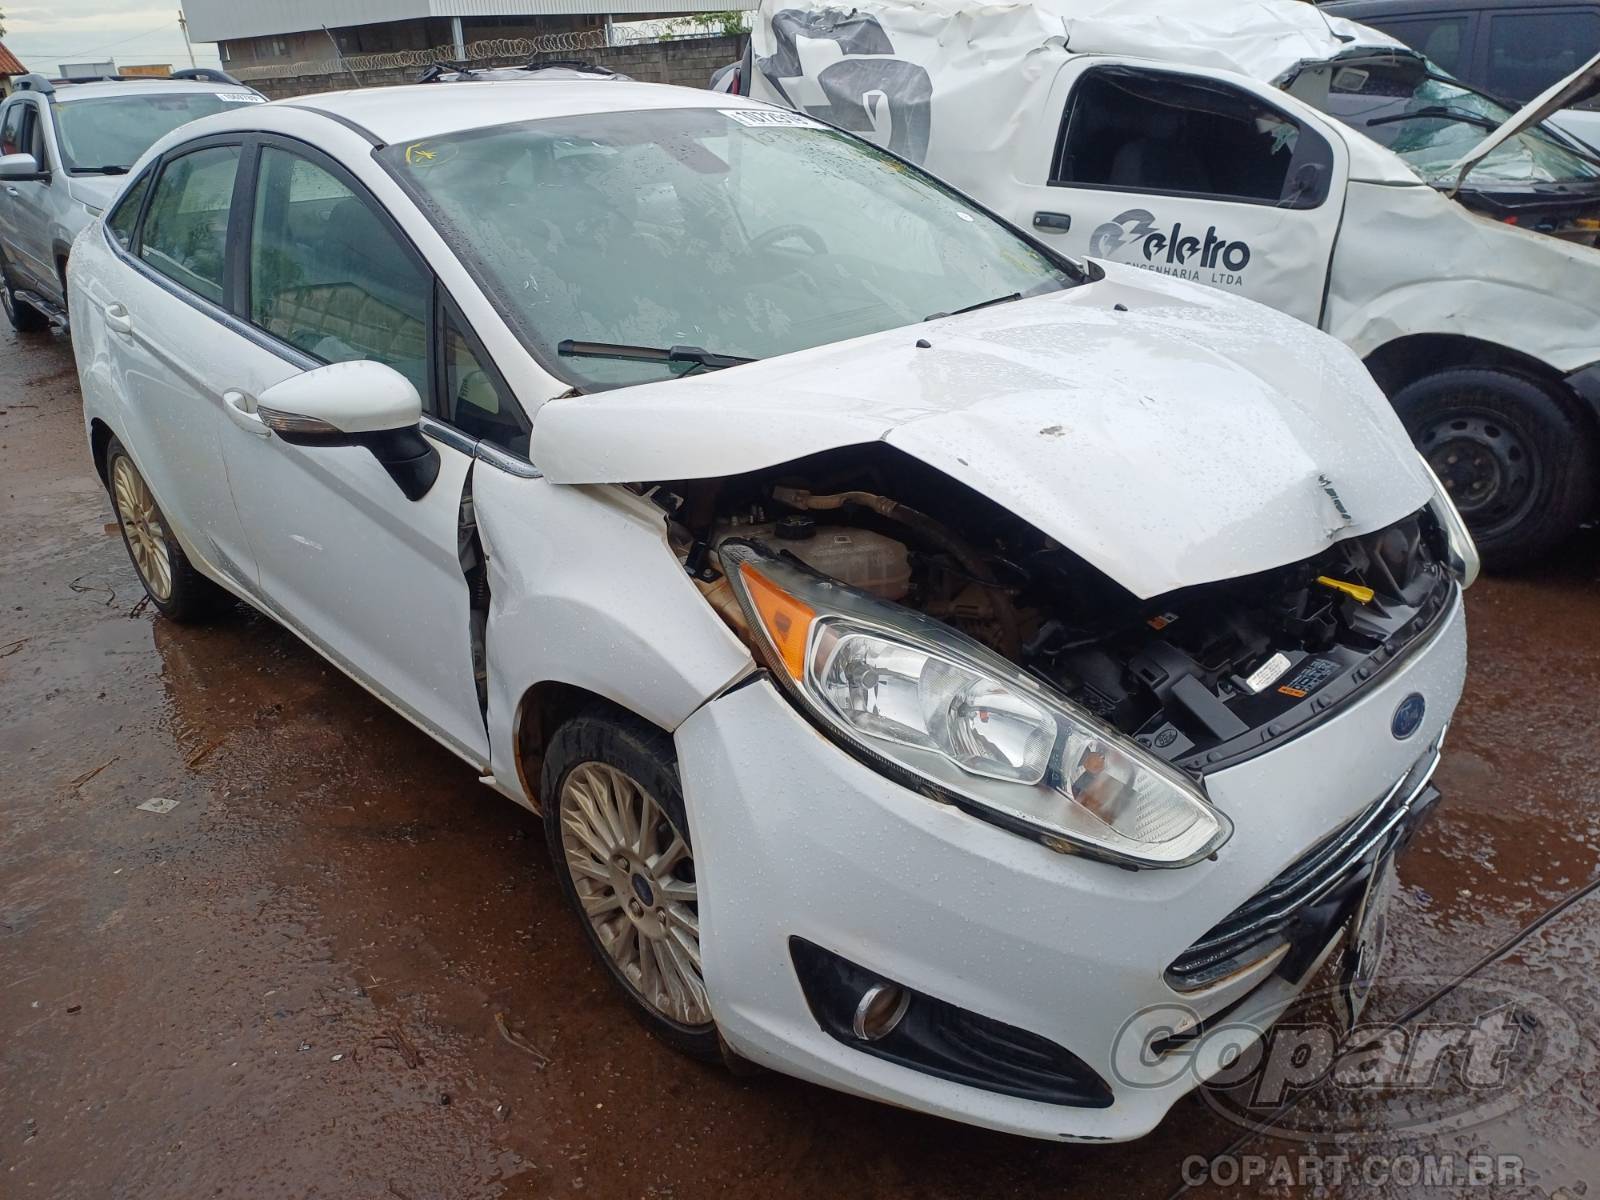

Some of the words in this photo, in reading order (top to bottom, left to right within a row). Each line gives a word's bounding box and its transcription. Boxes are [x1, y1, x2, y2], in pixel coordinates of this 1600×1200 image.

[1143, 222, 1250, 271] eletro
[1124, 262, 1200, 280] GENHARIA
[1211, 272, 1243, 286] LTDA
